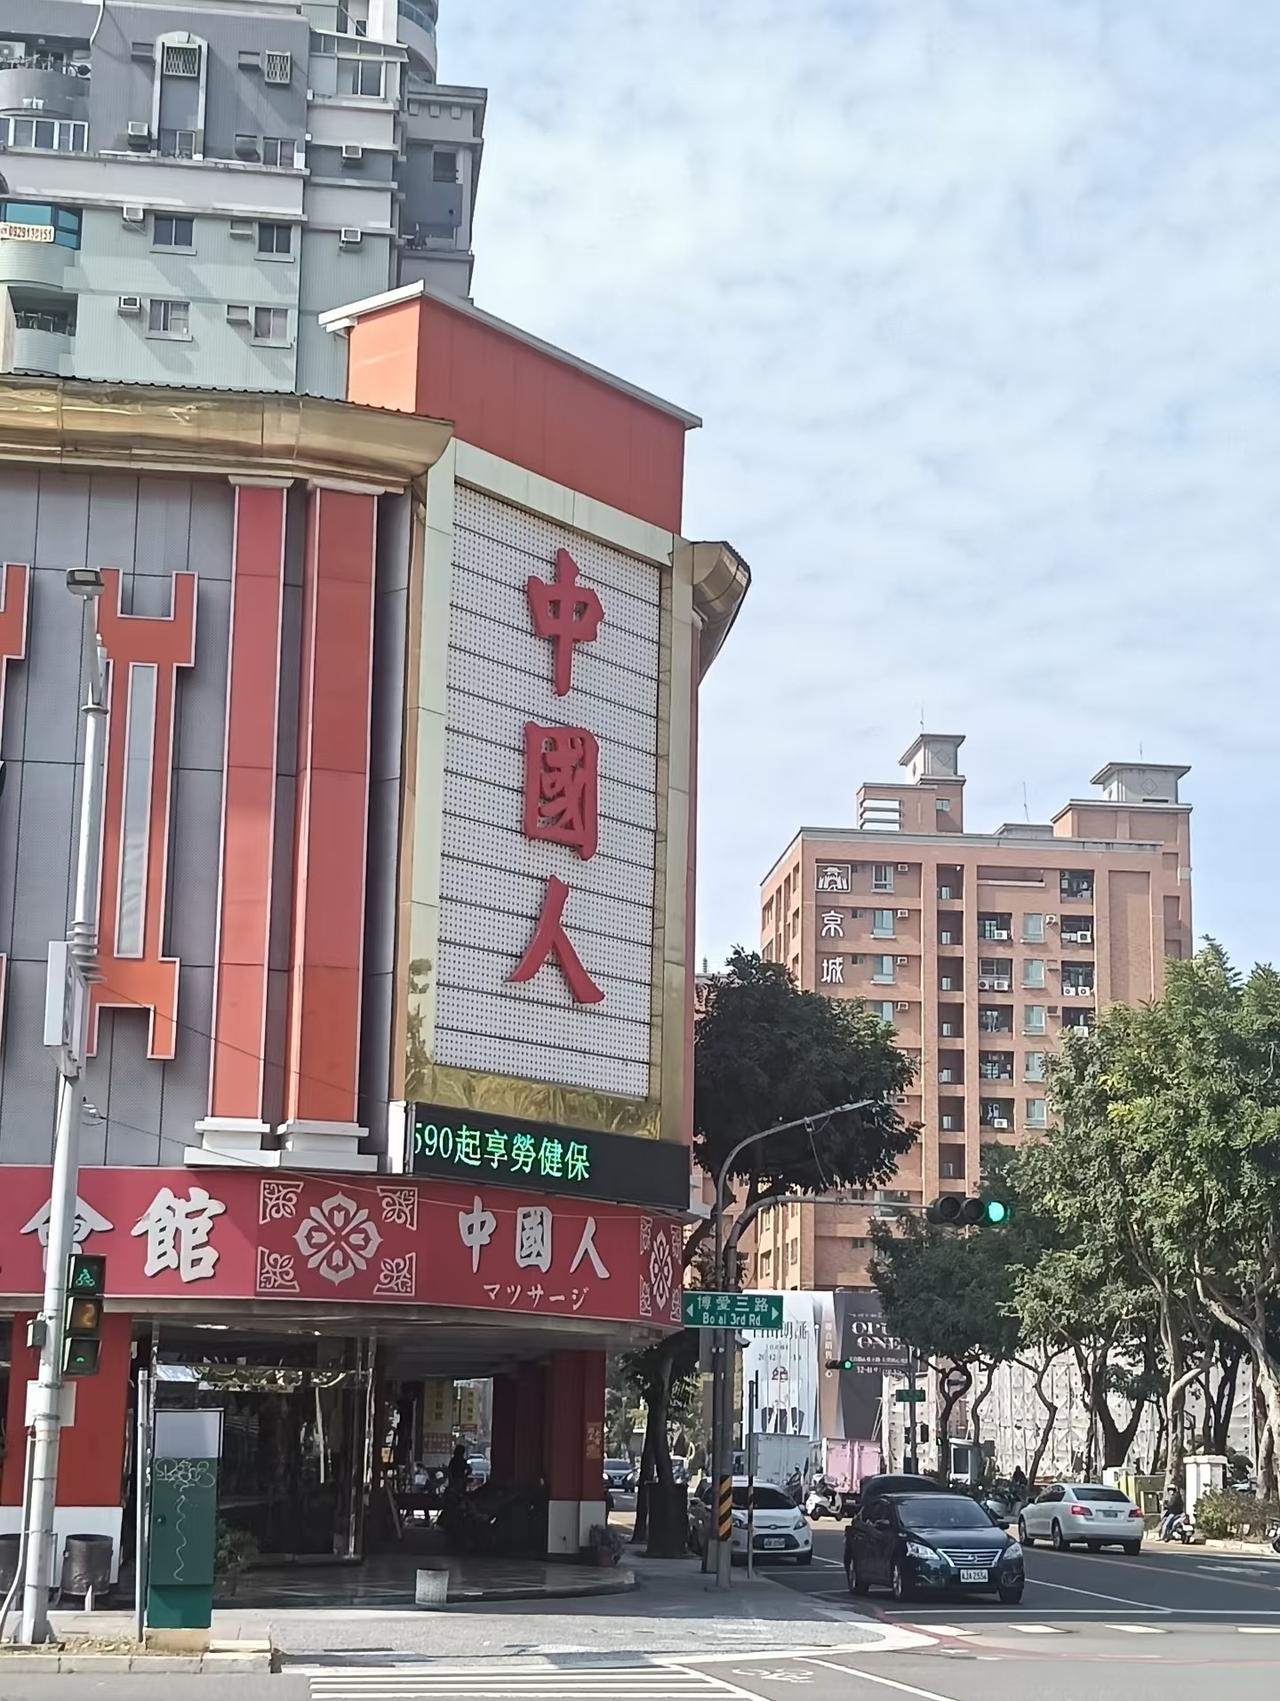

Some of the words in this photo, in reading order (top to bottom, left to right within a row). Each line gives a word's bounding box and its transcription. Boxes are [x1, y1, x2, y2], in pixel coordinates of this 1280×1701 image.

[503, 548, 605, 1004] 中國人
[821, 910, 845, 984] 京城
[458, 1195, 611, 1279] 中國人
[697, 1295, 769, 1313] 博愛三路
[730, 1313, 746, 1326] 3rd
[748, 1314, 761, 1327] Rd
